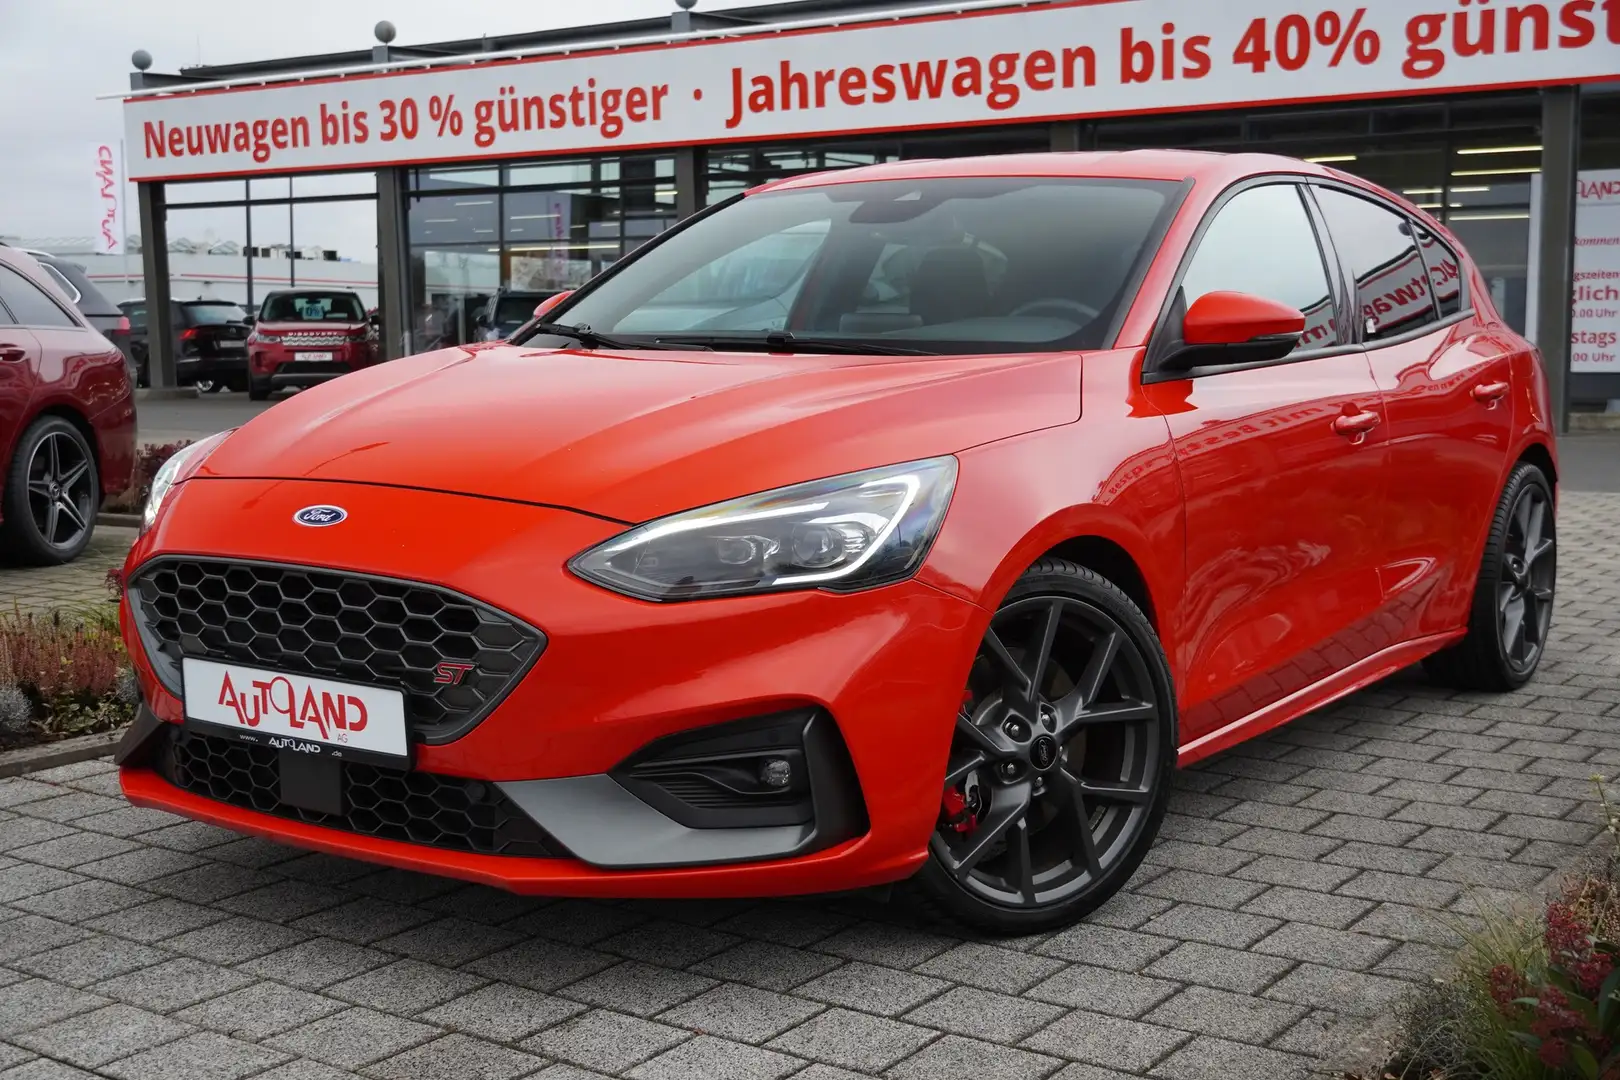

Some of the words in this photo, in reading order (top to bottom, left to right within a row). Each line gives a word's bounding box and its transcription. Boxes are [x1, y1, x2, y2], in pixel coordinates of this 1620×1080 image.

[144, 115, 310, 163] Neuwagen
[320, 100, 369, 146] bis
[379, 97, 418, 142] 30
[474, 77, 668, 148] günstiger
[725, 43, 1096, 129] Jahreswagen
[1119, 22, 1212, 84] bis
[1233, 8, 1380, 73] 40%
[1595, 307, 1616, 318] Uhr
[1592, 352, 1616, 362] Uhr
[303, 507, 336, 522] Ford
[433, 662, 476, 685] ST
[337, 732, 349, 744] AG
